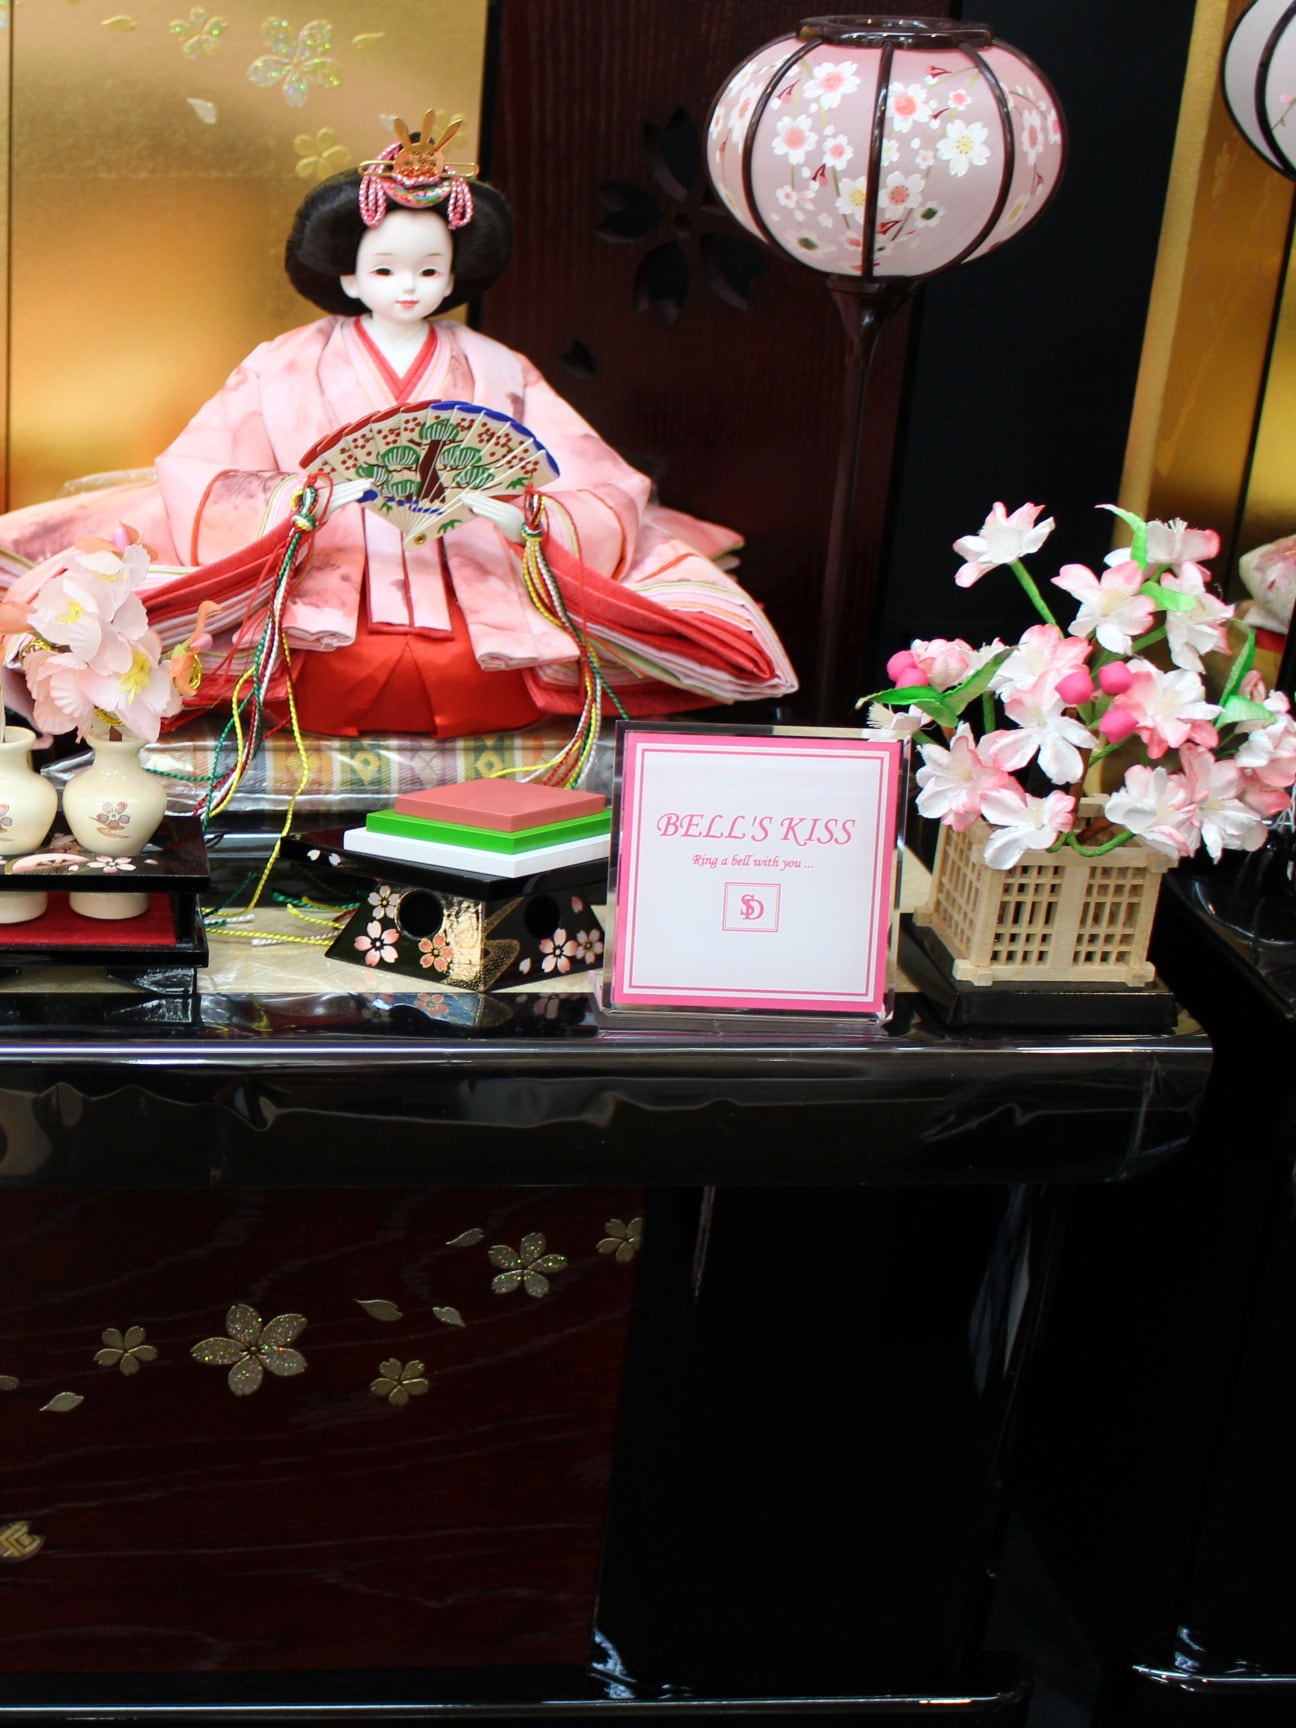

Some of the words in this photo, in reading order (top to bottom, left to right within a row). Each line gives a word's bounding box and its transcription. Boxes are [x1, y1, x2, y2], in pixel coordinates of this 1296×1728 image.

[657, 812, 772, 842] BELL'S
[780, 817, 856, 847] KISS
[692, 855, 718, 870] Ring
[721, 859, 728, 867] a
[731, 854, 751, 868] bell
[753, 857, 779, 869] with
